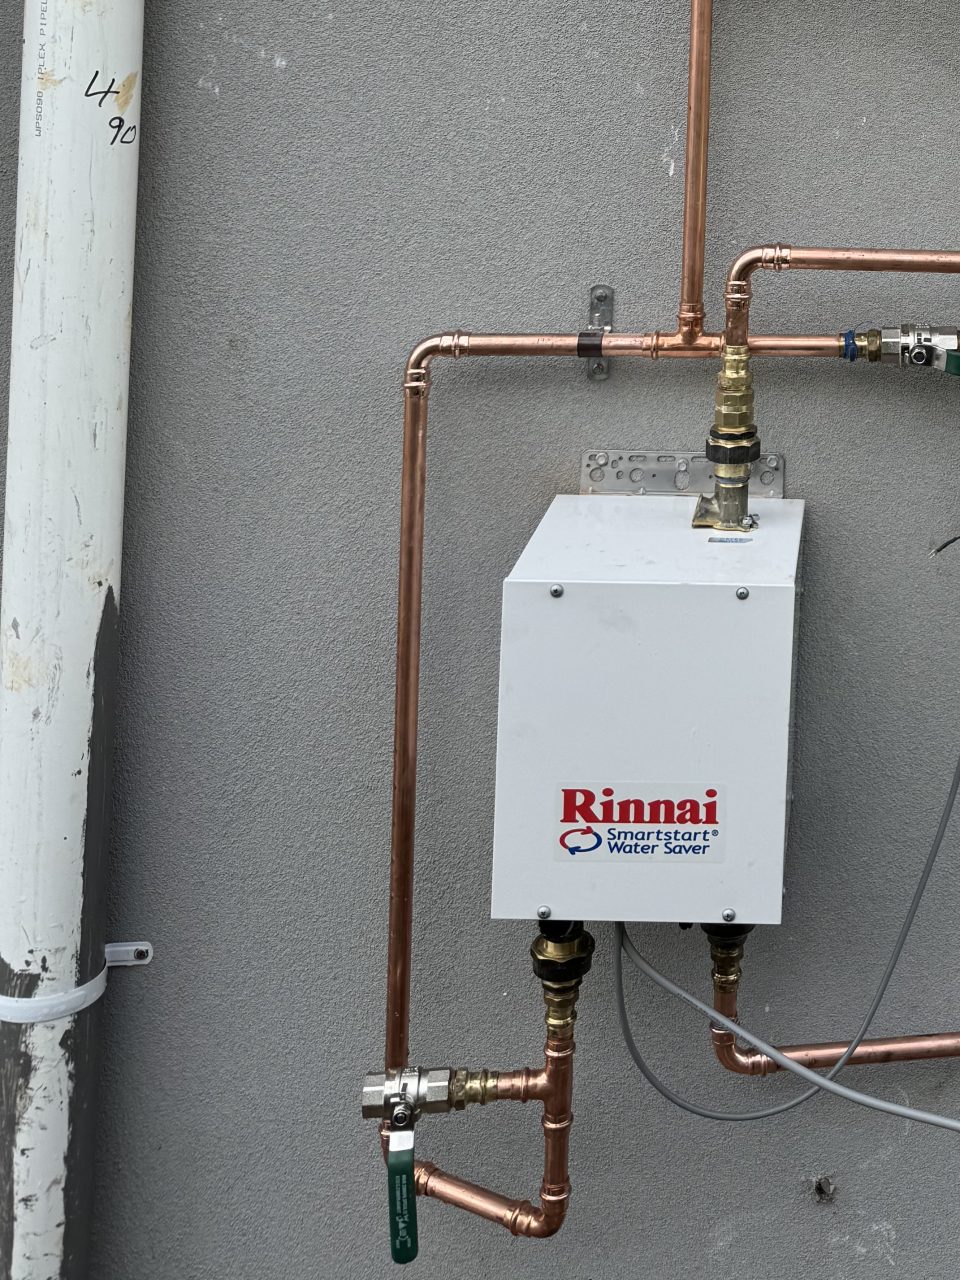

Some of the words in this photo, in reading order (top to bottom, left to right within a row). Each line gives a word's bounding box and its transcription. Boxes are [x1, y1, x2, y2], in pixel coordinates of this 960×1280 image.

[38, 43, 46, 80] IPLEX
[84, 70, 120, 108] 4
[108, 116, 137, 146] 90
[560, 787, 719, 825] Rinnai
[607, 841, 659, 854] Water
[664, 841, 710, 855] Saver
